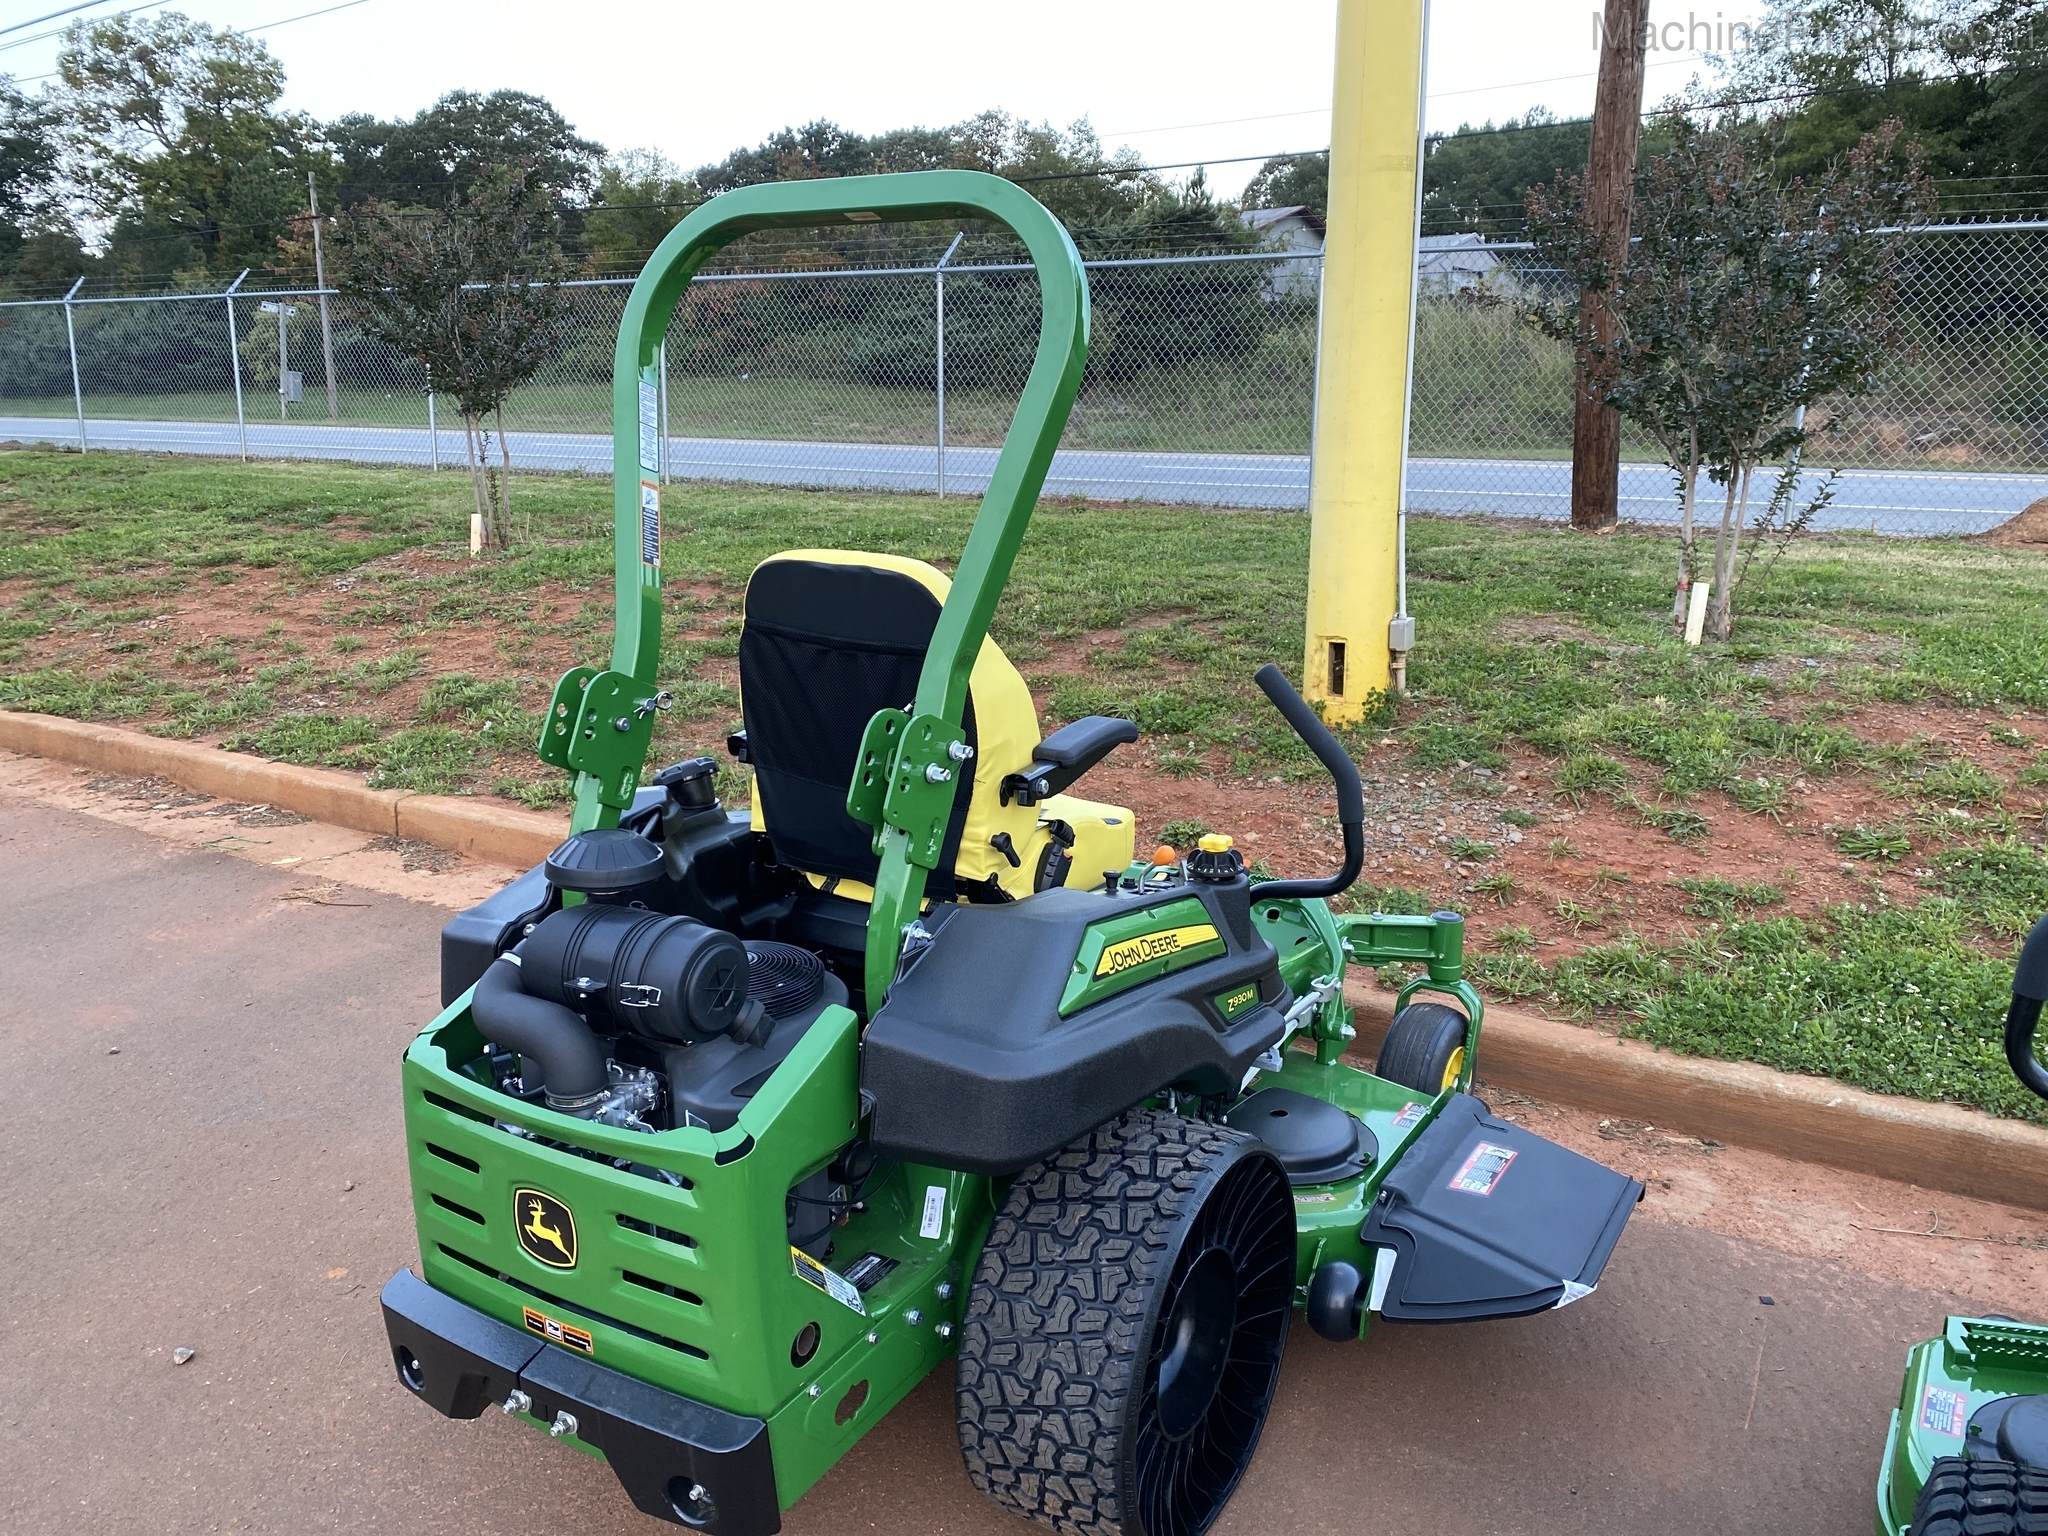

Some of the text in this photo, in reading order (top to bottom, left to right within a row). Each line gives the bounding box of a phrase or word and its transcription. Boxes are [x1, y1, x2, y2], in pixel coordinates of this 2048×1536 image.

[1108, 933, 1181, 971] JOHN DEERE
[1227, 988, 1254, 1013] Z930M
